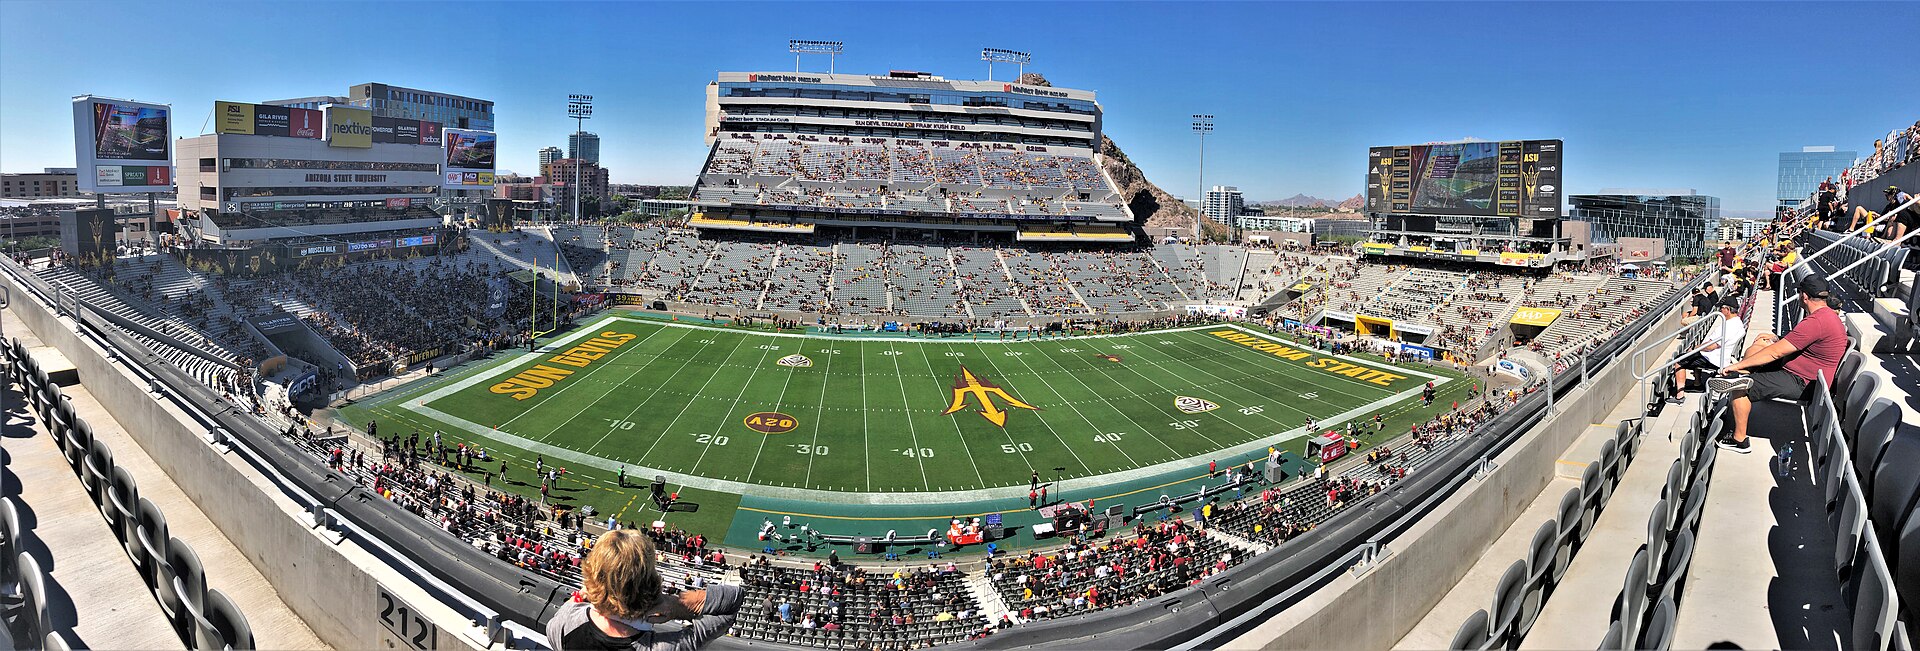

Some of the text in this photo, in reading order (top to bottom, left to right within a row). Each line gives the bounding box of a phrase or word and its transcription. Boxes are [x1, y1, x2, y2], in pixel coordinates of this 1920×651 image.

[227, 104, 241, 113] ASU
[333, 121, 371, 136] nextiva
[1380, 157, 1392, 166] ASU
[1524, 153, 1539, 162] ASU
[304, 173, 387, 183] ARIZONA STATE UNIVERSITY
[307, 245, 337, 254] MUSCLE MILK
[547, 330, 638, 368] DEVILS
[411, 348, 439, 364] INFERNO
[1208, 330, 1409, 386] ARIZONA STATE
[488, 363, 576, 401] SUN
[1298, 391, 1319, 400] 10
[1238, 405, 1264, 416] 20
[608, 419, 636, 430] 10
[1168, 419, 1199, 430] 30
[695, 434, 730, 446] 20
[1093, 432, 1122, 443] 40
[796, 444, 829, 456] 30
[902, 447, 935, 458] 40
[1000, 442, 1034, 454] 50
[381, 592, 428, 650] 212
